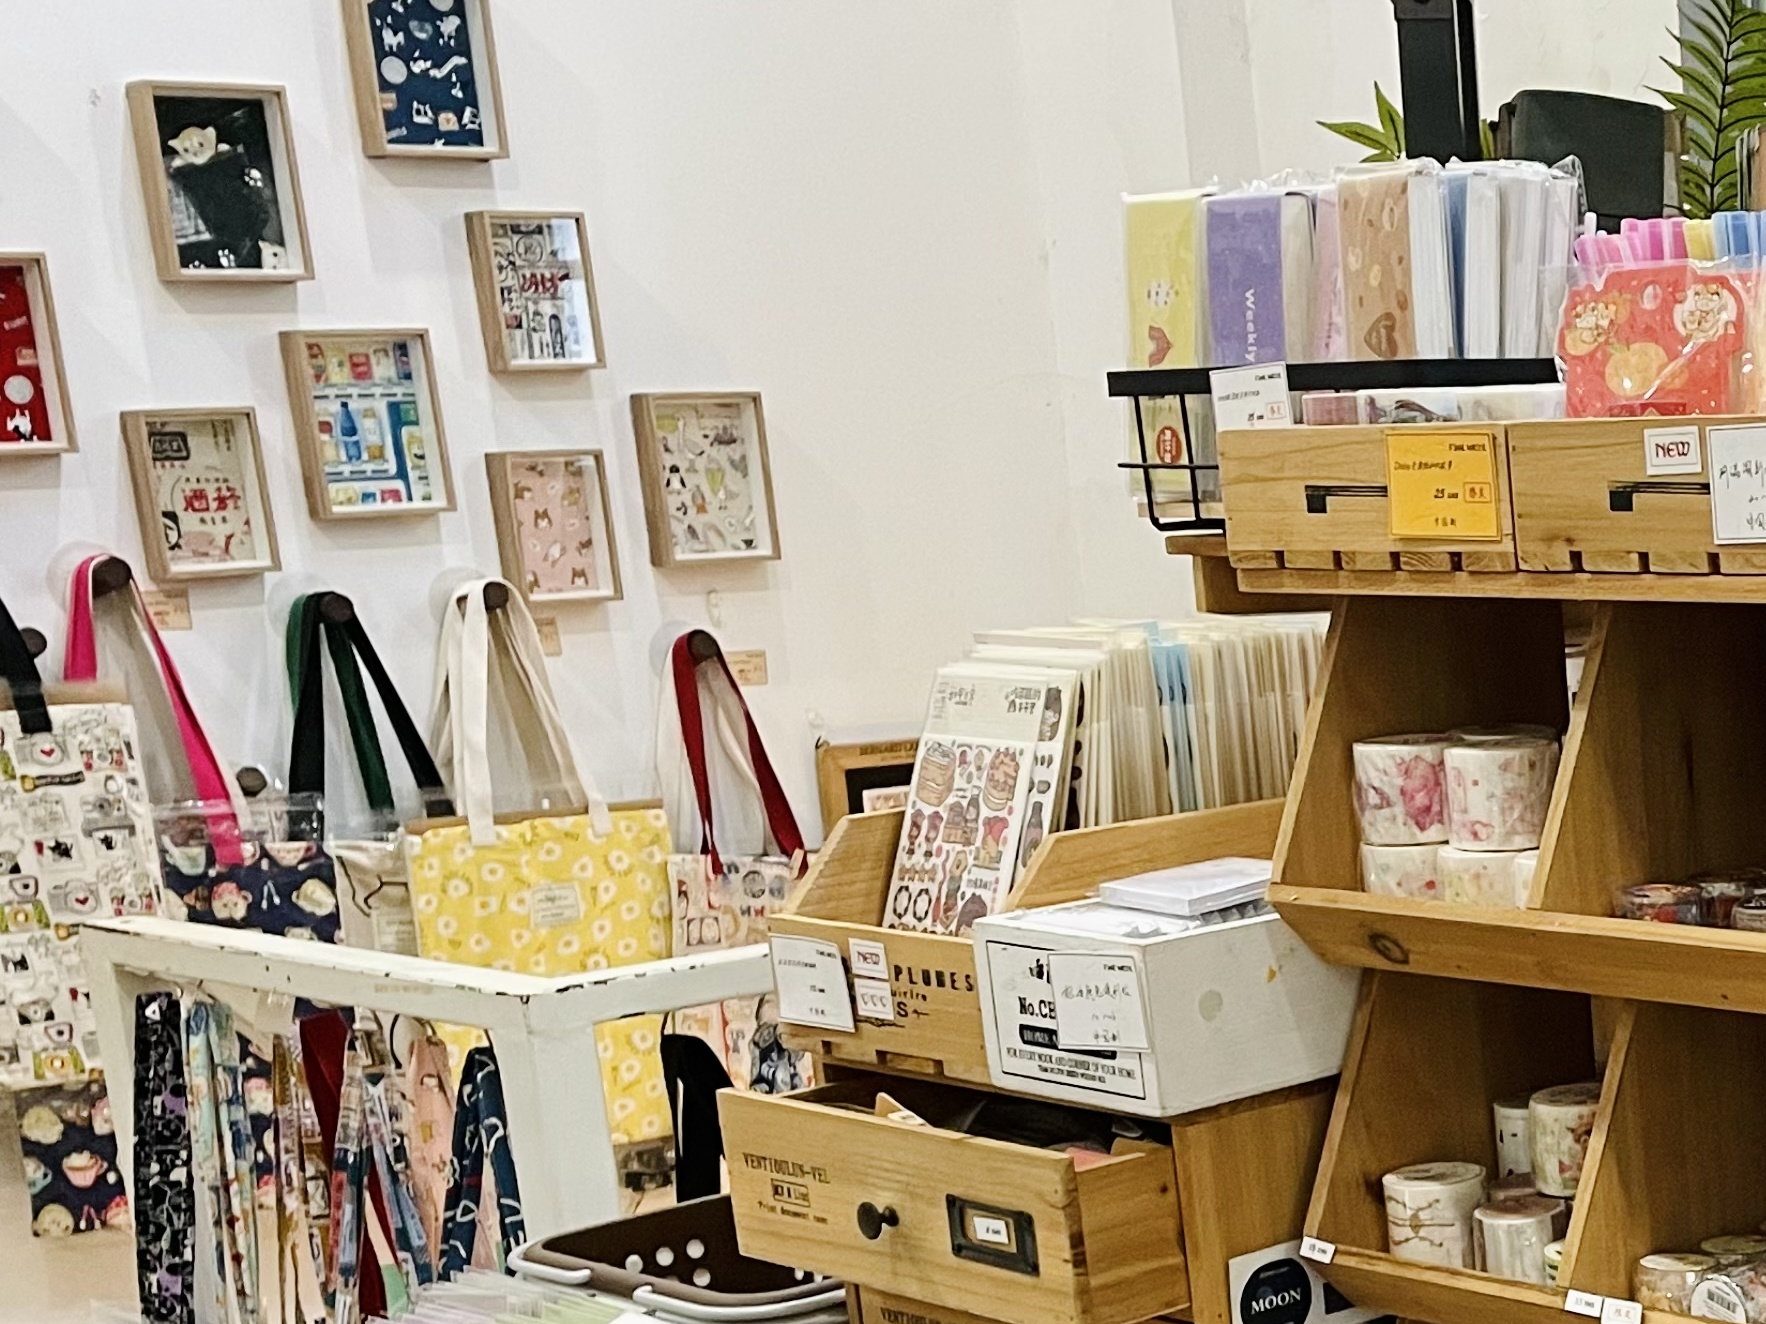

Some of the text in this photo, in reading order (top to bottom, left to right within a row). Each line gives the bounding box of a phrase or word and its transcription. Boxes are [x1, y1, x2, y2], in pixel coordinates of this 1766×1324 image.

[1244, 288, 1258, 363] Weekly
[1654, 442, 1691, 459] NEW
[1250, 1287, 1302, 1315] MOON
